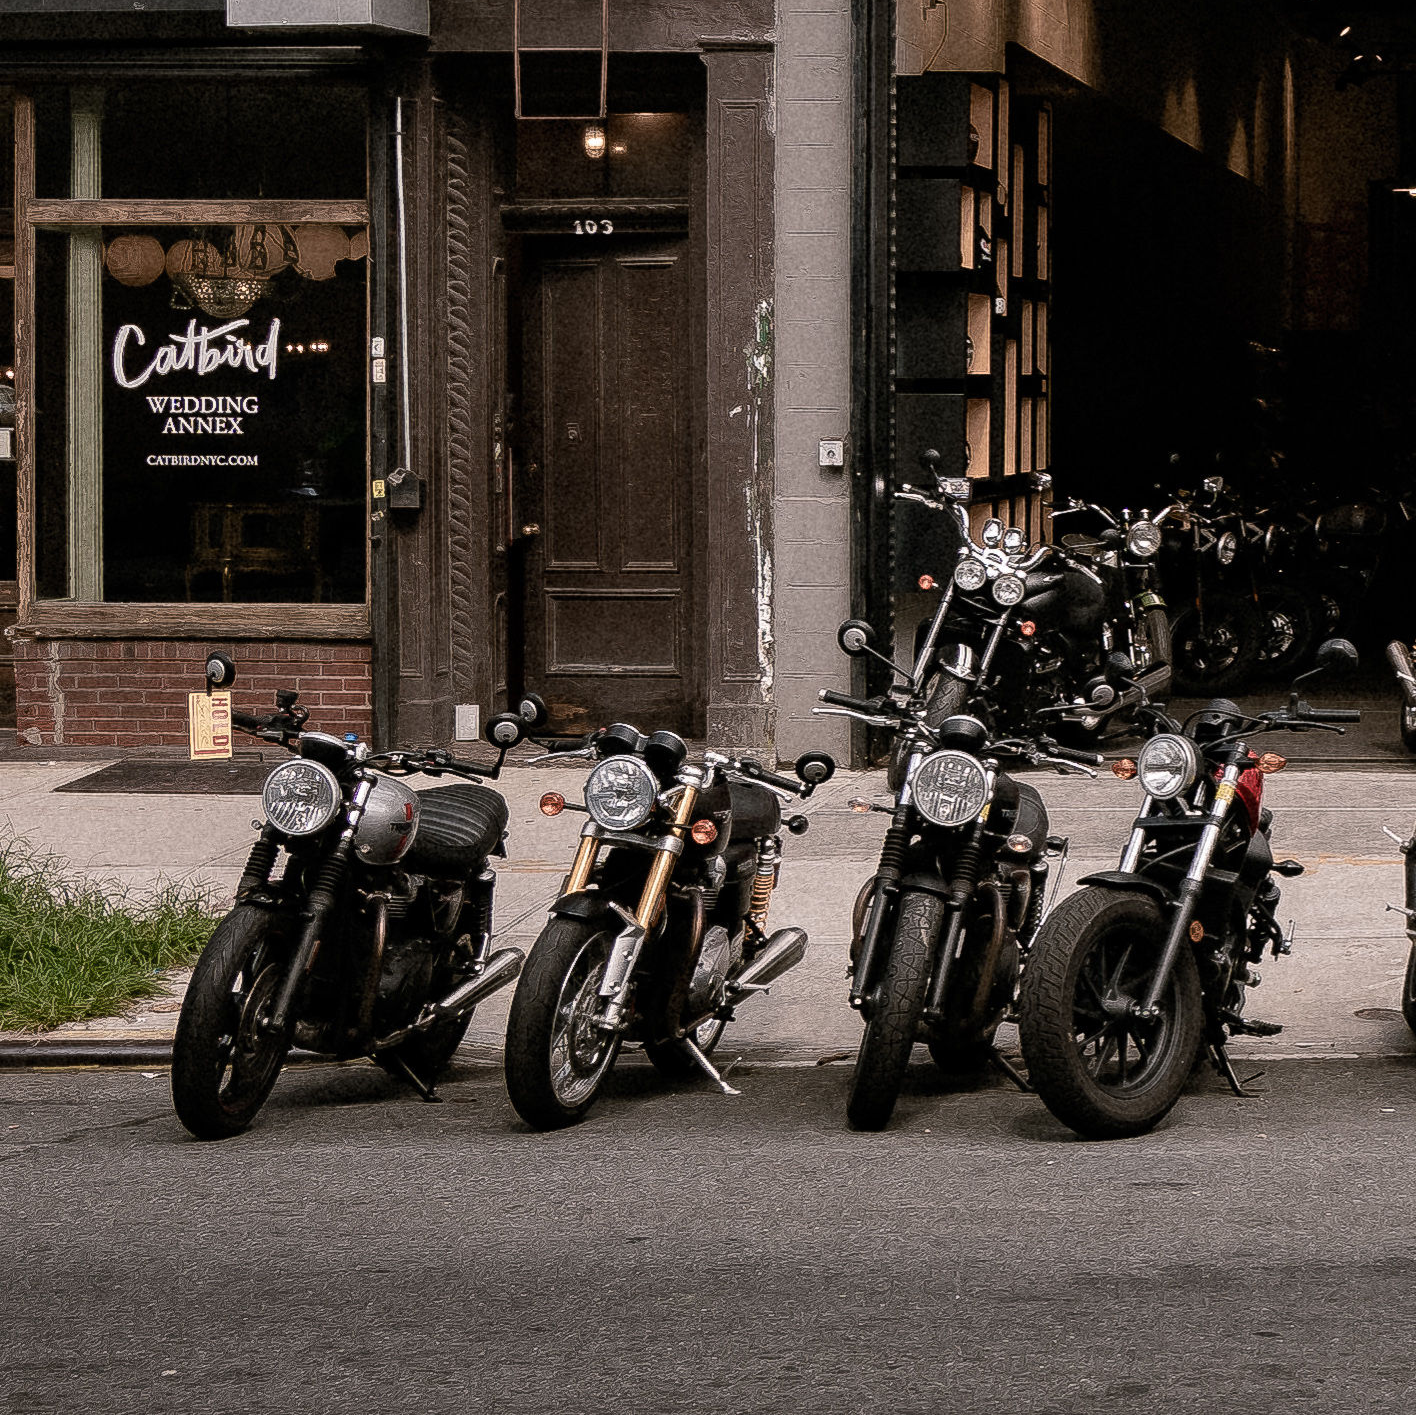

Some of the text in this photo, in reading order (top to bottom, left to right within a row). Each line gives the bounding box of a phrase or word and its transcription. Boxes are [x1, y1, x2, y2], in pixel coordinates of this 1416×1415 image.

[573, 220, 614, 235] 103
[113, 317, 282, 389] Catbird
[146, 396, 259, 414] WEDDING
[162, 417, 244, 435] ANNEX
[146, 454, 259, 466] CATBIRDNYC.COM
[211, 697, 230, 747] HOLD
